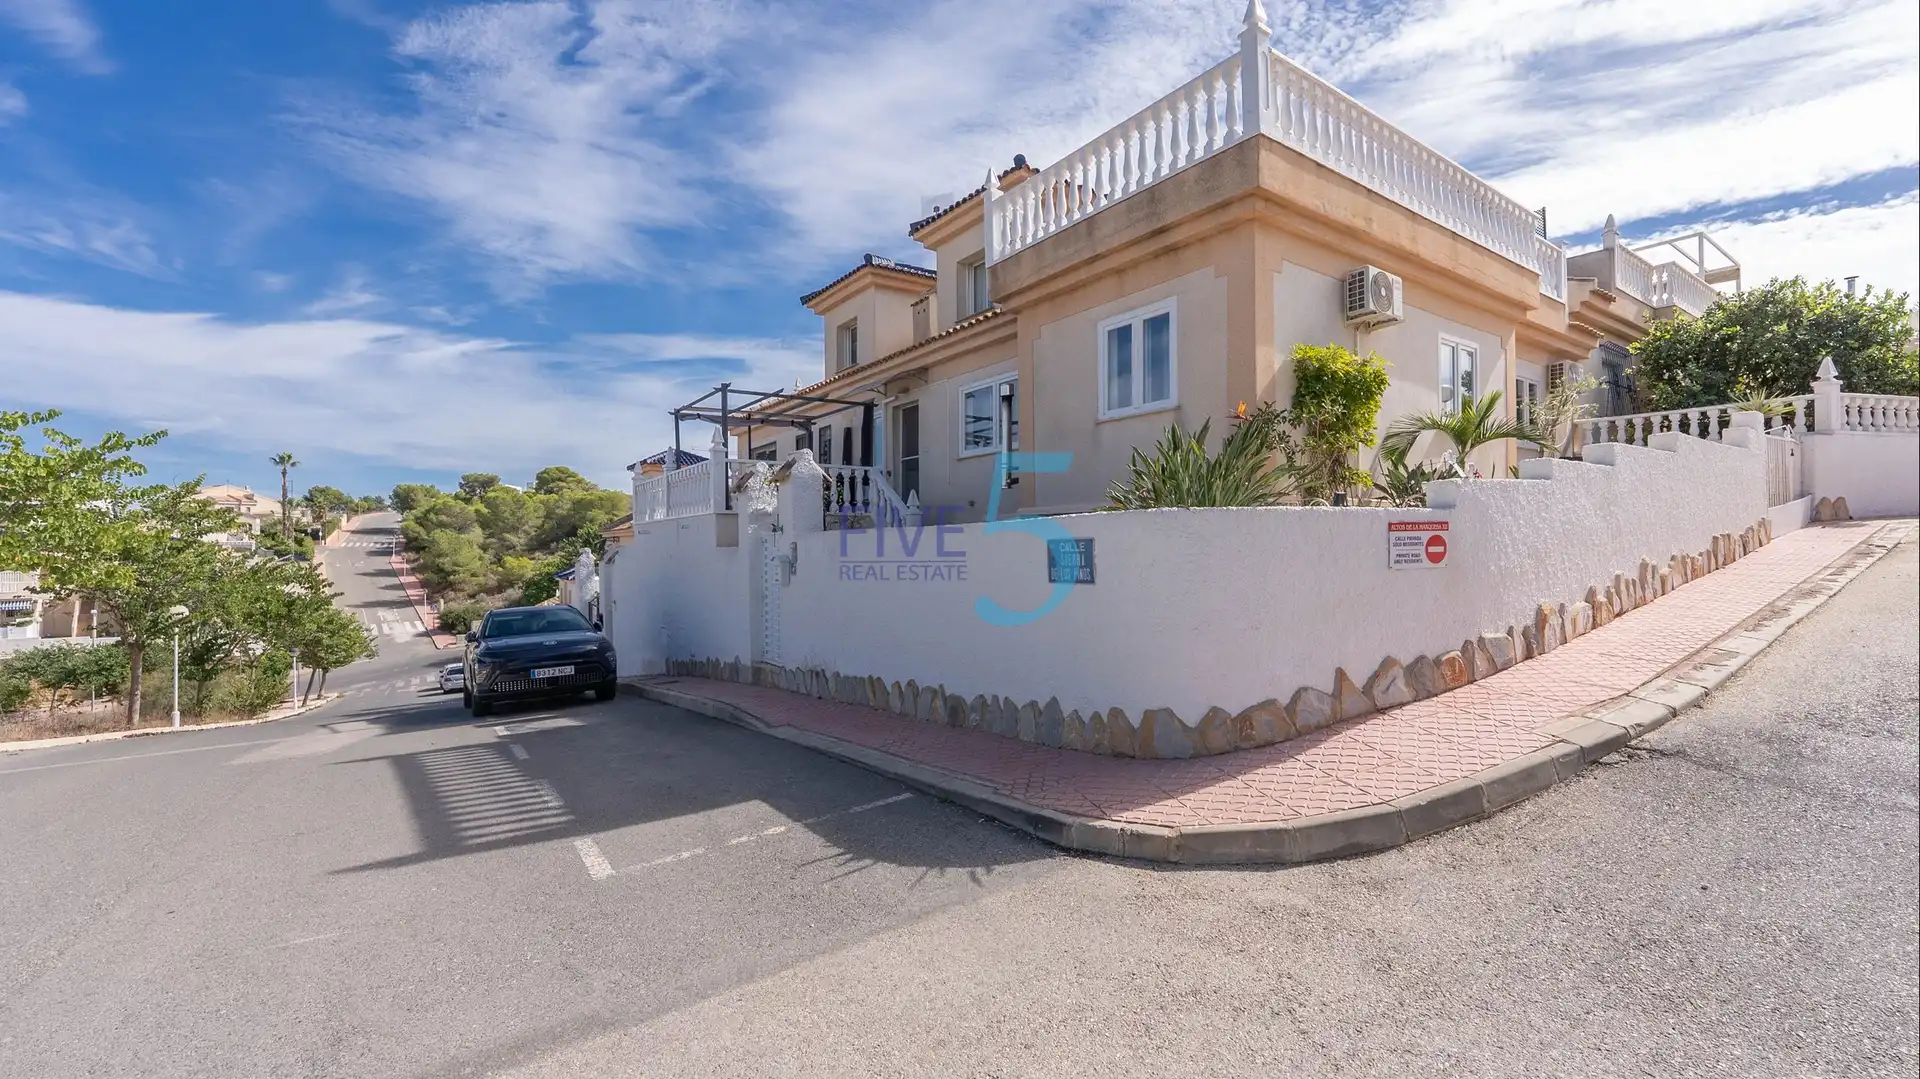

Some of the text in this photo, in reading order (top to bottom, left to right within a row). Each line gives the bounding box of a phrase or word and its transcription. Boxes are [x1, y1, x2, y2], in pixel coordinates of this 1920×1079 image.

[1060, 542, 1085, 551] CALLE
[1060, 553, 1086, 566] SIERRA
[536, 668, 556, 676] 8312
